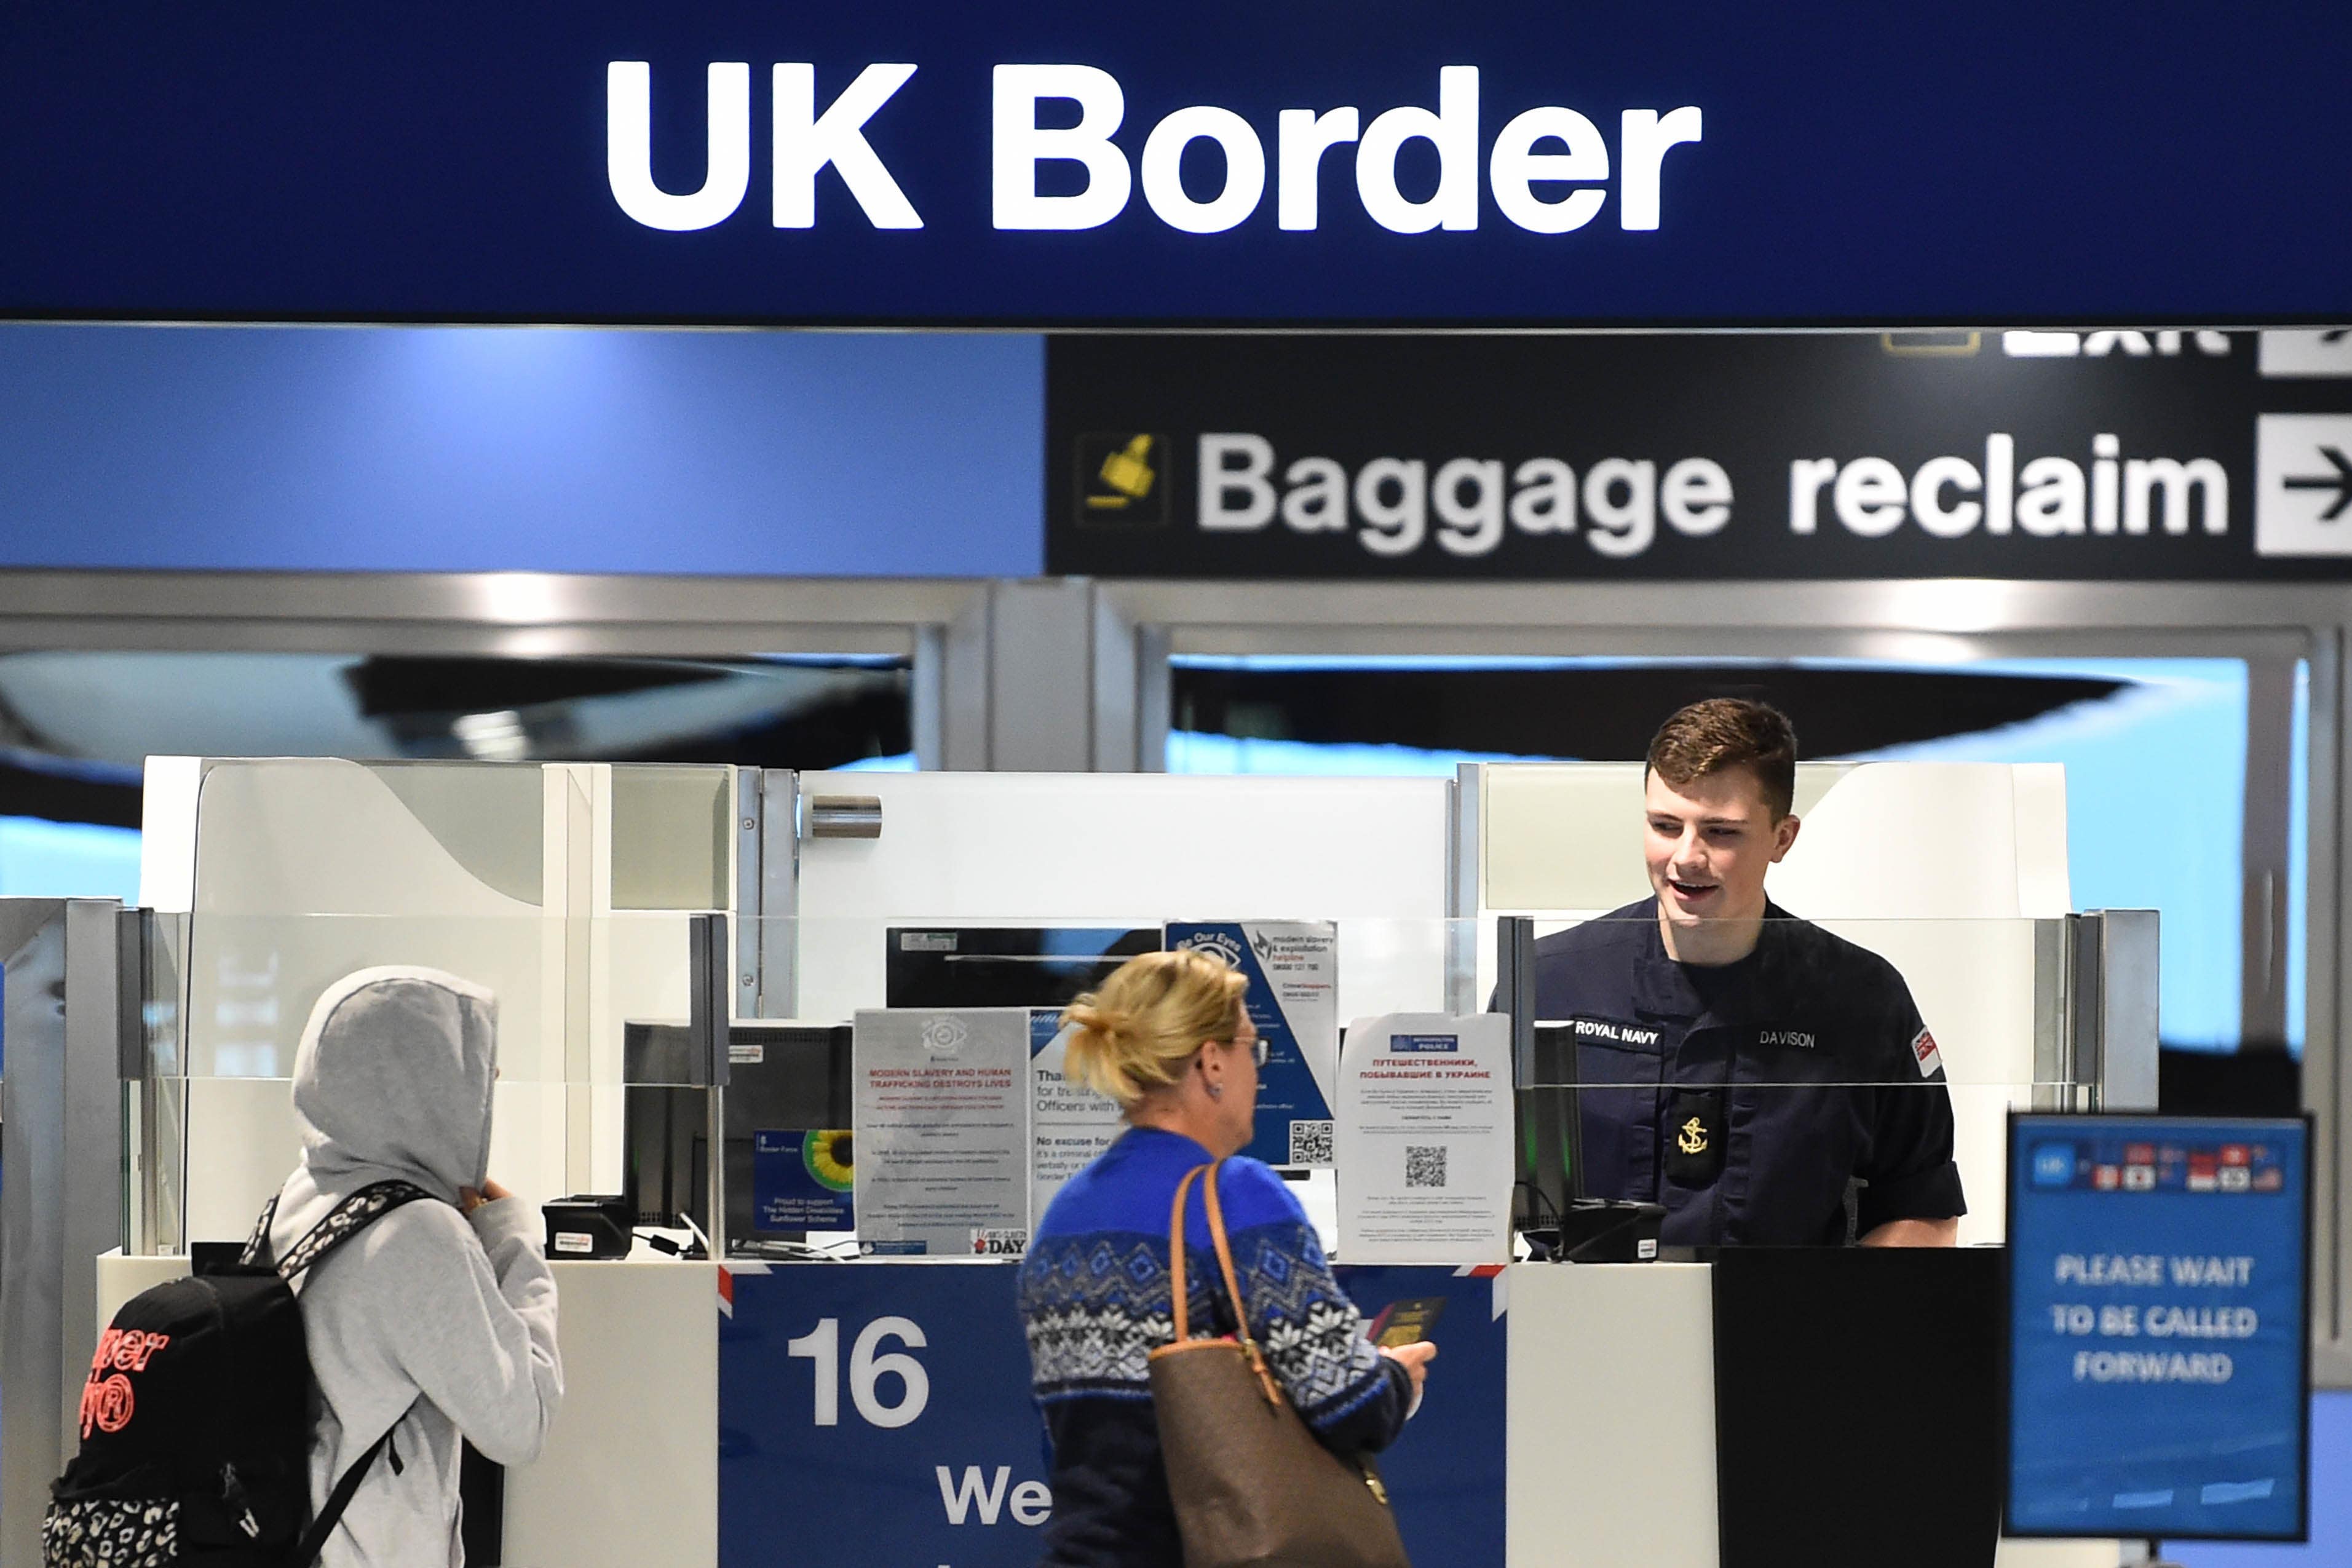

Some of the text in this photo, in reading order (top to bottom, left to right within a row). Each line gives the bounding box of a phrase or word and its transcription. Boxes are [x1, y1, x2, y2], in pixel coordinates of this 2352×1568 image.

[608, 61, 1702, 234] UK Border
[1200, 433, 2227, 556] Baggage reclaim
[1194, 932, 1215, 943] Our
[1217, 932, 1241, 952] Eyes
[1575, 1021, 1659, 1045] ROYAL NAVY
[1760, 1031, 1815, 1048] DAVISON
[1037, 1086, 1053, 1096] for
[1037, 1099, 1114, 1112] Officers with
[1037, 1137, 1051, 1146] No
[1095, 1137, 1110, 1146] for
[988, 1239, 1027, 1254] DAY
[2054, 1254, 2255, 1287] PLEASE WAIT
[2051, 1304, 2259, 1337] TO BE CALLED
[789, 1317, 929, 1427] 16
[2073, 1351, 2233, 1384] FORWARD
[936, 1466, 1051, 1525] We
